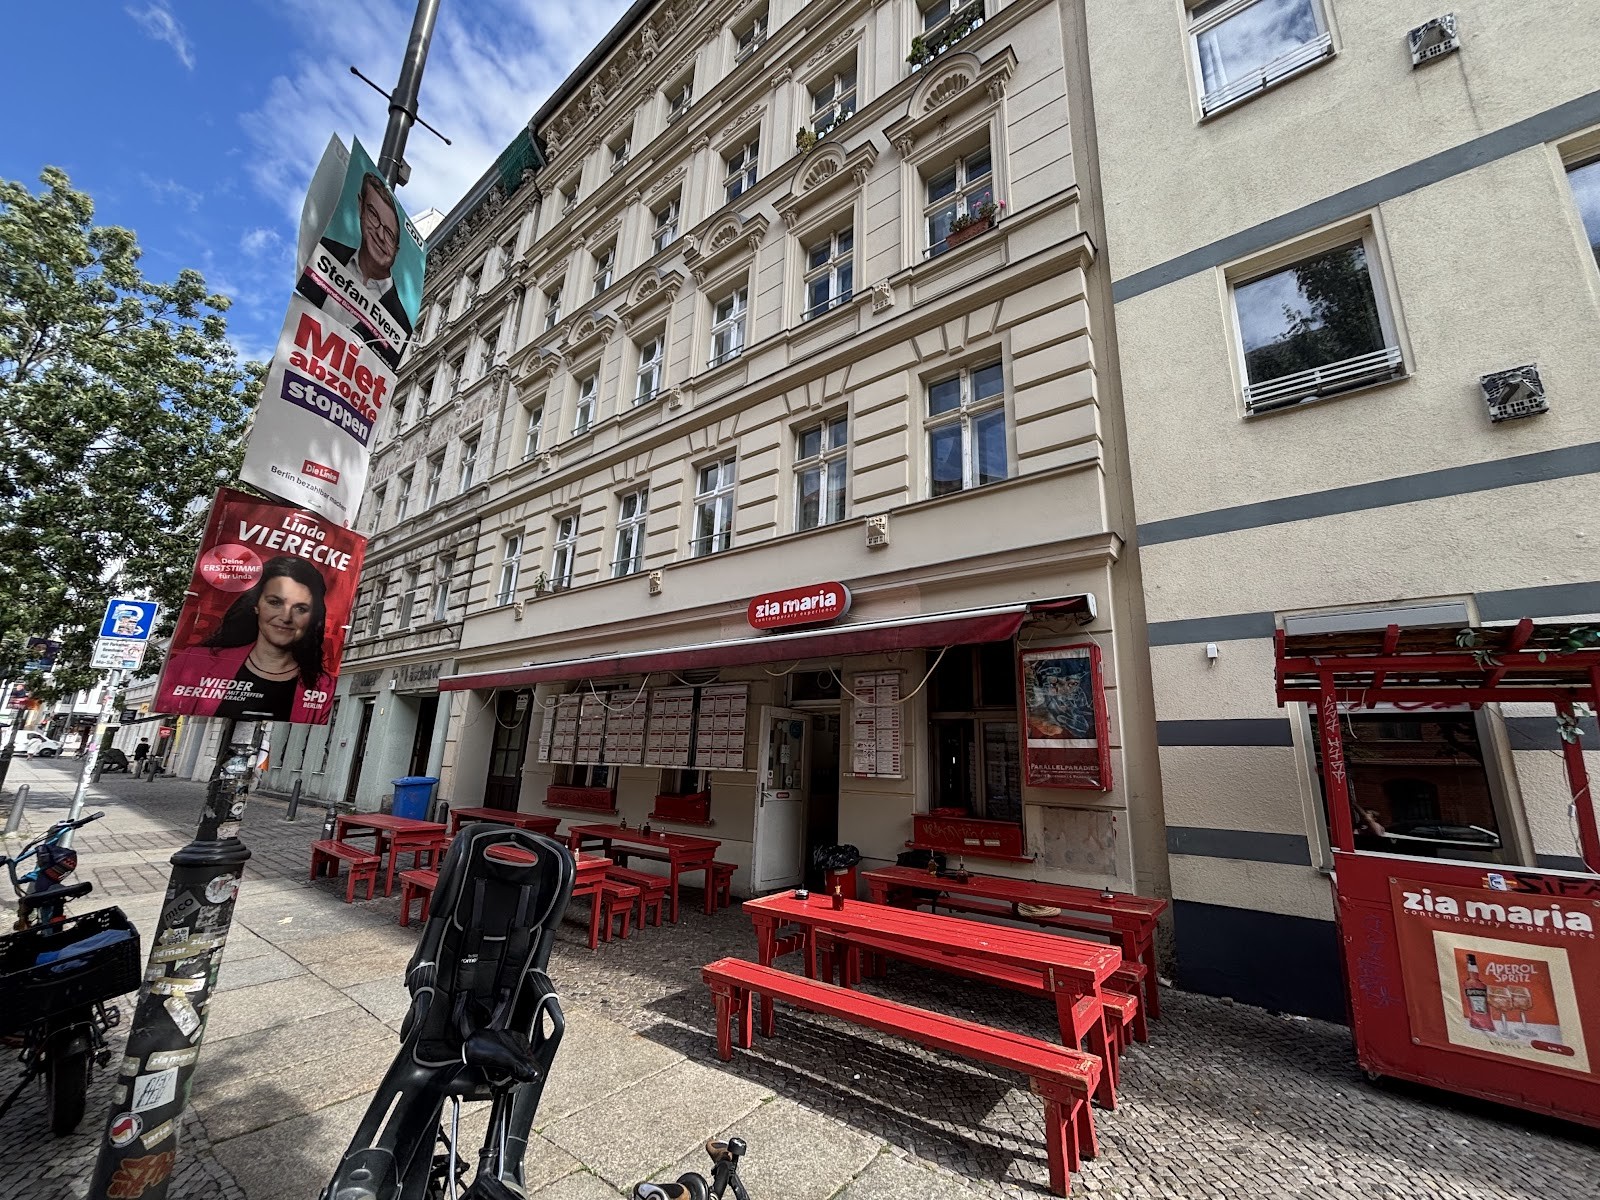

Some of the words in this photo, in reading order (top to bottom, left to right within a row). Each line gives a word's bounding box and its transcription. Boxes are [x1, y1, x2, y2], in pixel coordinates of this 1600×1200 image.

[405, 222, 423, 247] CDU
[317, 255, 369, 311] Stefan
[369, 303, 401, 345] Evers
[294, 312, 388, 410] Miet
[289, 349, 378, 423] abzocke
[287, 378, 371, 445] stoppen
[270, 465, 296, 482] Berlin
[296, 477, 330, 499] bezahlbar
[305, 464, 320, 475] Die
[319, 468, 337, 482] Linke
[281, 516, 326, 541] Linda
[238, 520, 352, 572] VIERECKE
[203, 564, 261, 572] ERSTSTIMME
[755, 599, 780, 618] zia
[782, 589, 837, 613] maria
[172, 685, 227, 700] BERLIN
[239, 691, 265, 699] STEFFEN
[199, 677, 254, 691] WIEDER
[302, 690, 328, 703] SPD
[302, 702, 324, 710] BERLIN
[1402, 888, 1459, 915] zia
[1465, 900, 1593, 932] maria
[1403, 908, 1501, 929] contemporary
[1509, 922, 1596, 940] experience
[1485, 962, 1539, 976] APEROL
[1495, 973, 1531, 983] SPRITZ
